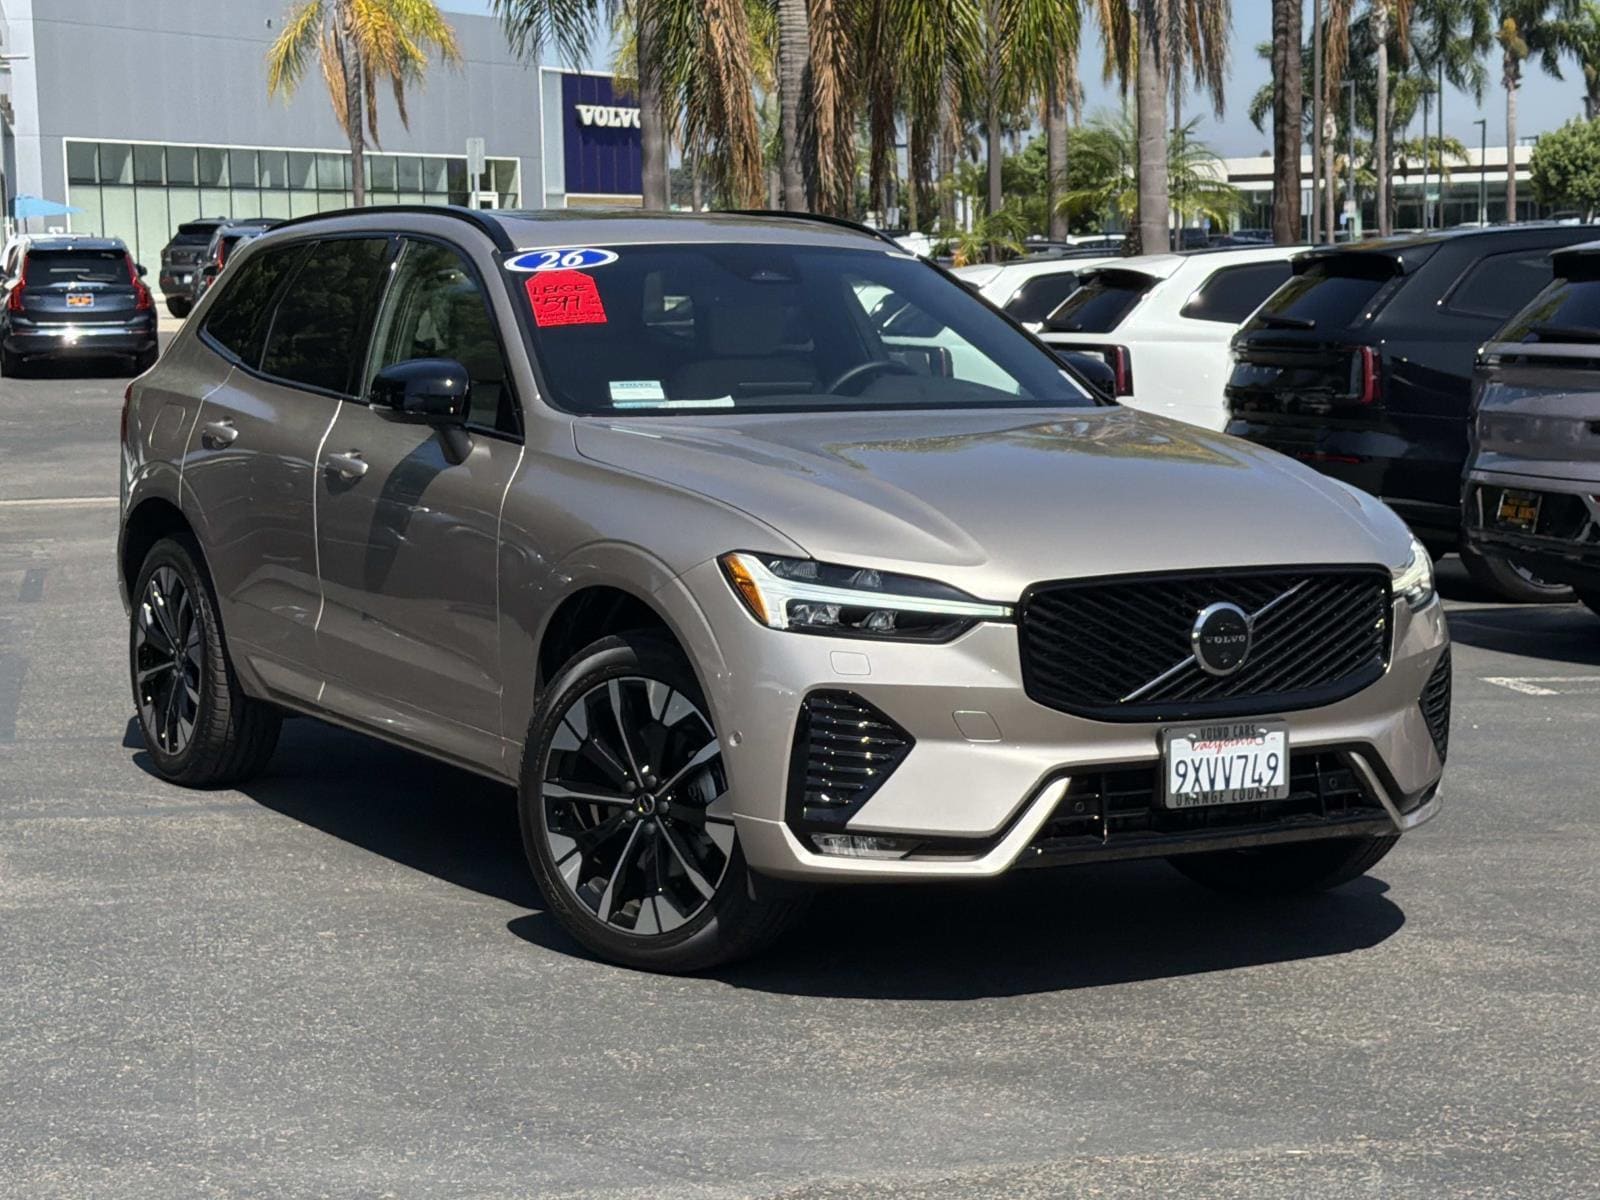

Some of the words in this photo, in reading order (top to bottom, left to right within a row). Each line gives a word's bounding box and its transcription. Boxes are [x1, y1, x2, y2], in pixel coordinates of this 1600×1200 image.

[536, 249, 585, 269] 26
[1204, 635, 1246, 644] VOLVO
[1200, 726, 1229, 740] VOLVO
[1233, 724, 1256, 738] CARS
[1175, 752, 1279, 793] 9XVV749
